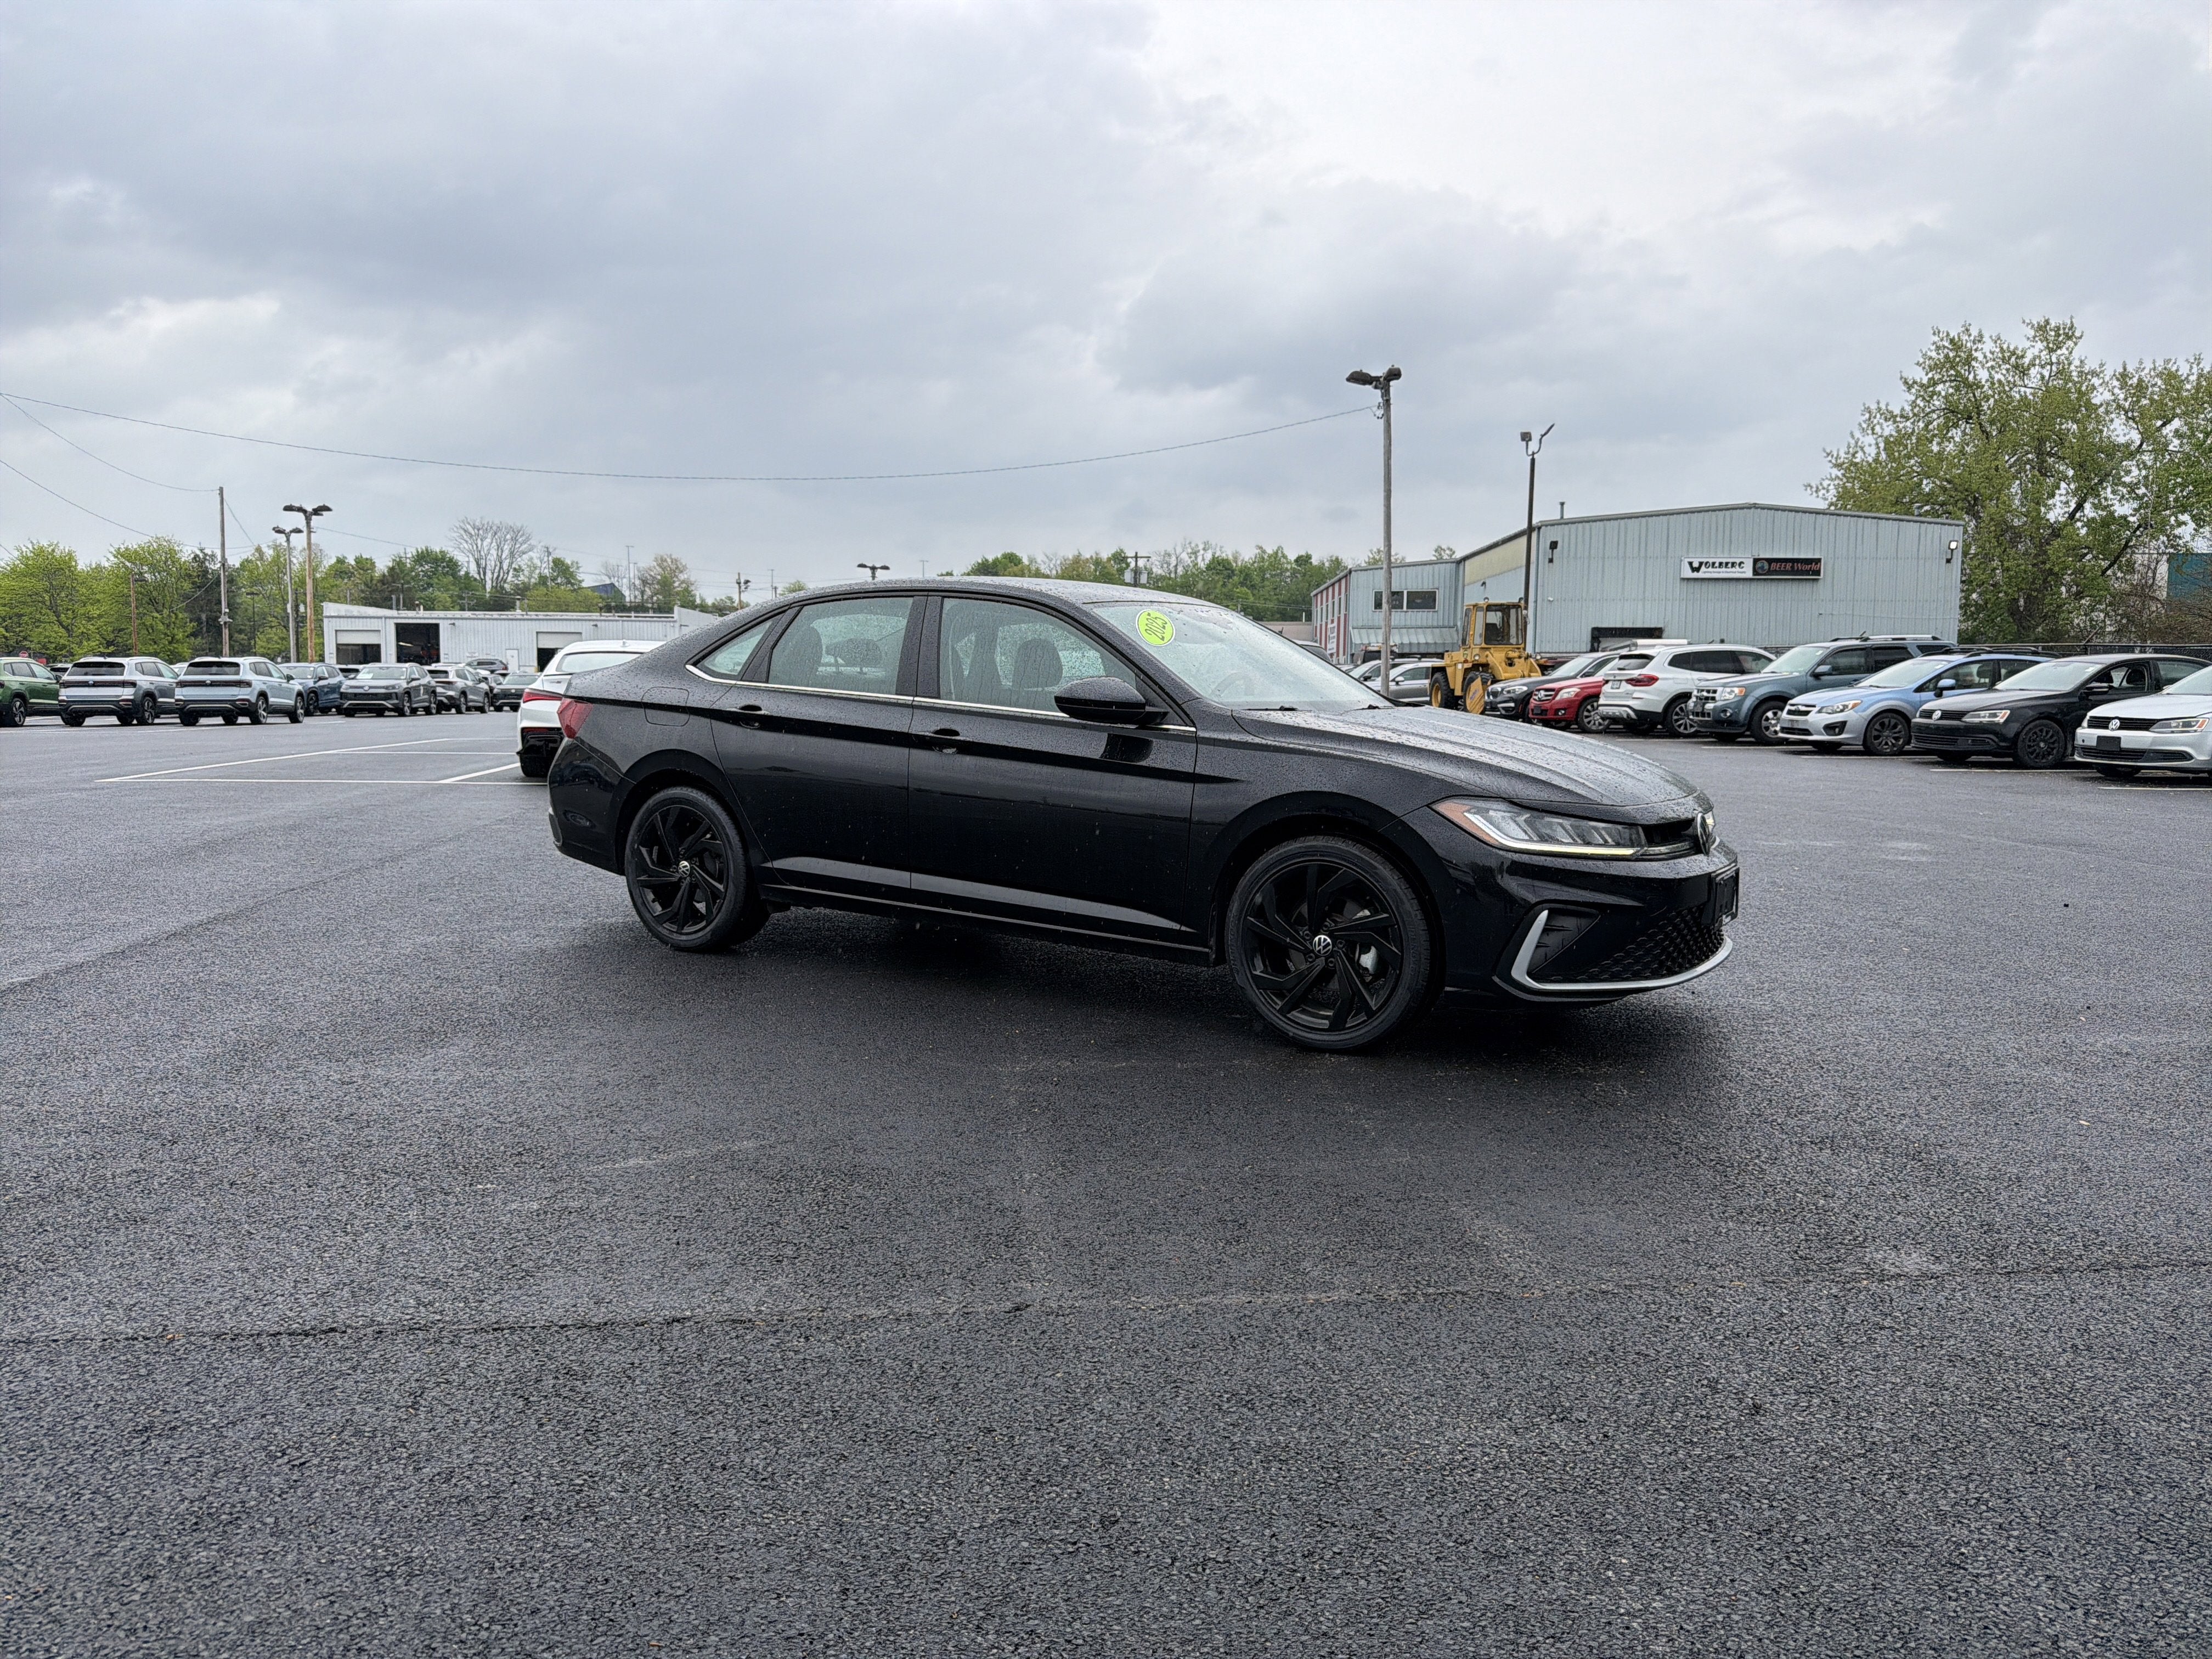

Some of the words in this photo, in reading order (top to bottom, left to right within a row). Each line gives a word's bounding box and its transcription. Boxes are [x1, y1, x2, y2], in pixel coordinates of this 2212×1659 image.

[1770, 562, 1792, 571] BEER
[1794, 562, 1820, 571] World
[1145, 612, 1168, 642] 2025
